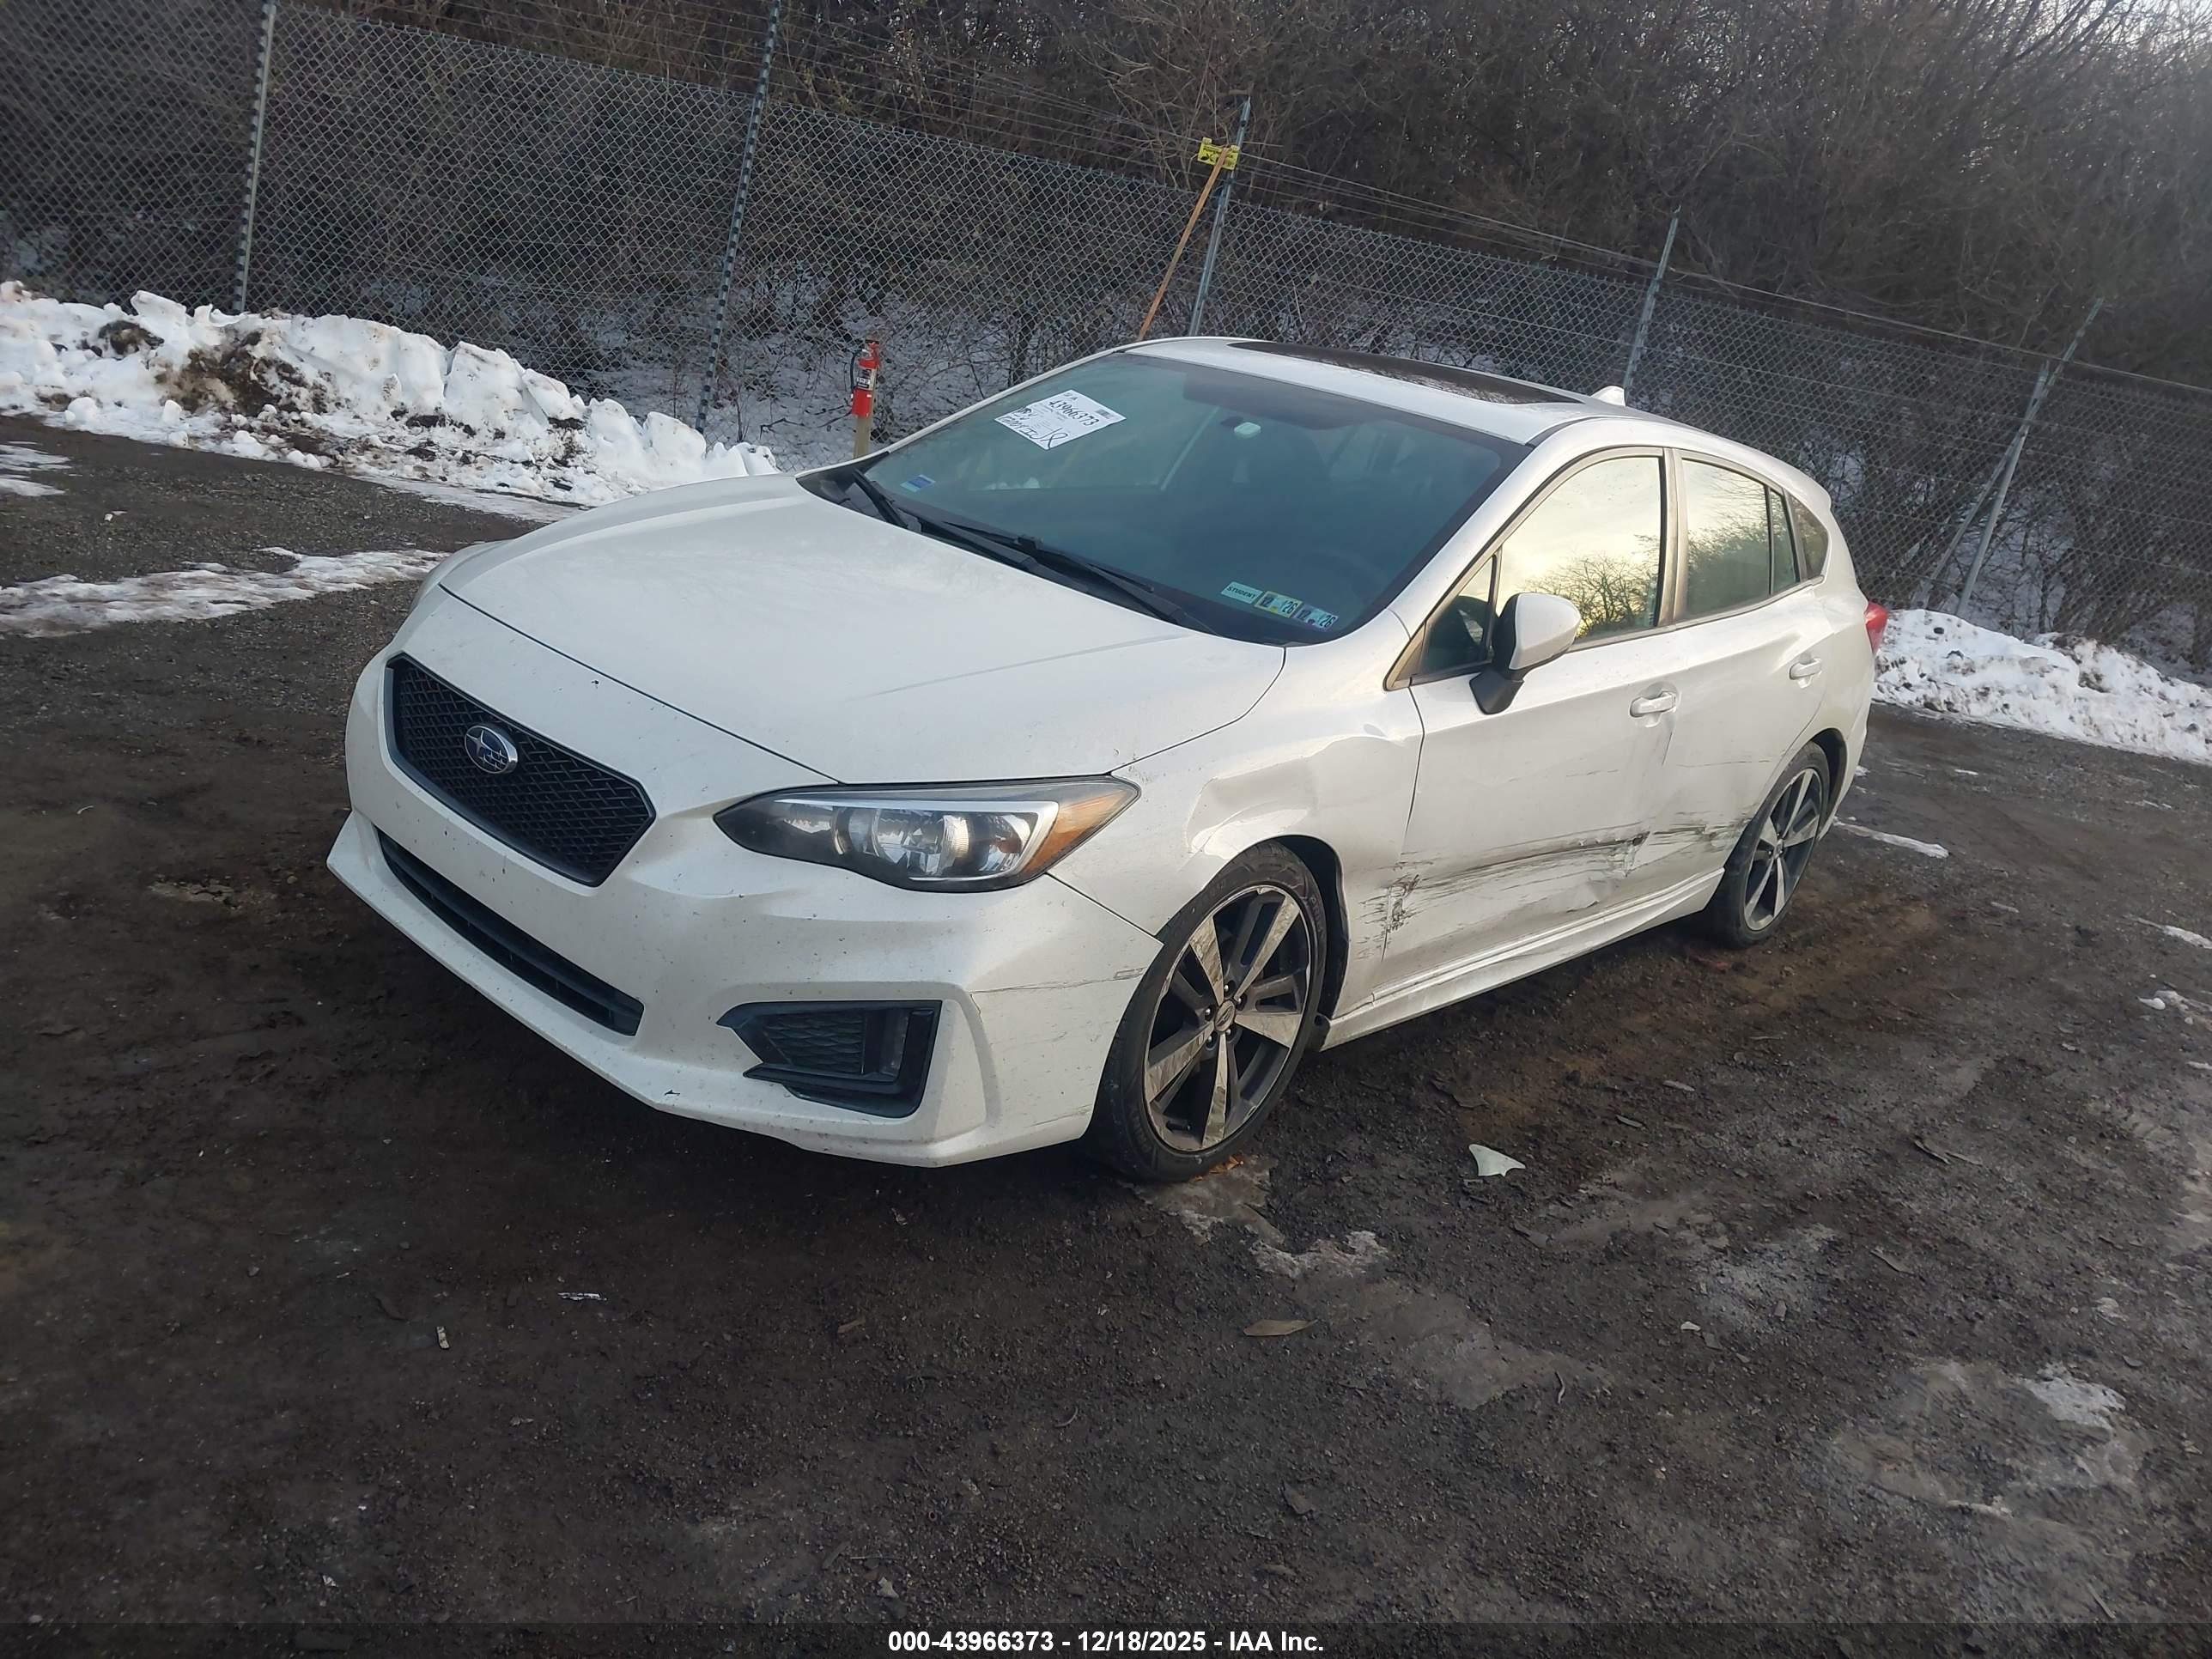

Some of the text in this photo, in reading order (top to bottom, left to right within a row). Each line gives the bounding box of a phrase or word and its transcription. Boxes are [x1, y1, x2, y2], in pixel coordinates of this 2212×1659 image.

[1048, 399, 1100, 427] 43966373
[1227, 586, 1255, 599] STUDENT
[1261, 596, 1274, 608] 12
